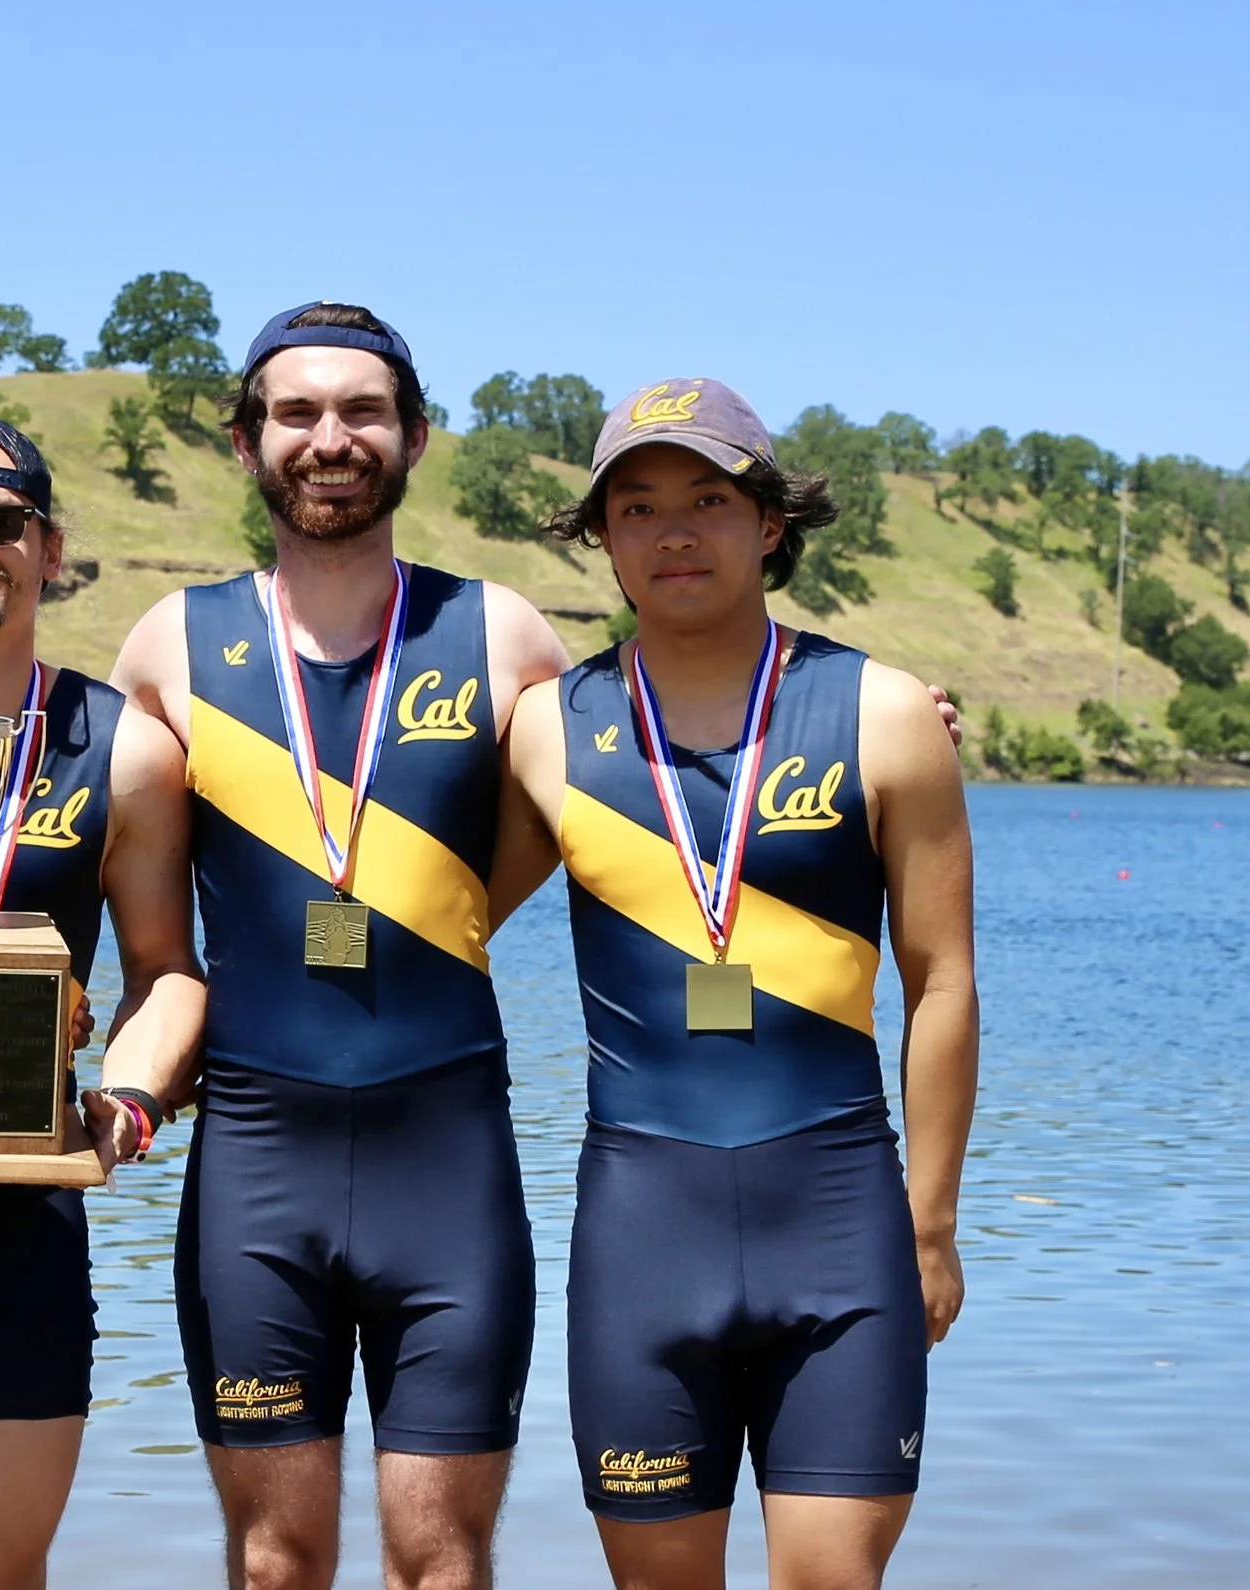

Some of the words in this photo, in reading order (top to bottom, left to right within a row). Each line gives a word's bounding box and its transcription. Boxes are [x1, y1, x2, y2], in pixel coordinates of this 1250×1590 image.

[627, 384, 700, 433] Cal
[396, 669, 478, 745] Cal
[757, 755, 845, 836] Cal
[215, 1376, 302, 1406] California
[216, 1405, 269, 1419] LIGHTWEIGHT
[271, 1399, 304, 1417] ROWING
[599, 1448, 690, 1479] California
[601, 1478, 656, 1493] LIGHTWEIGHT
[657, 1473, 690, 1491] ROWING
